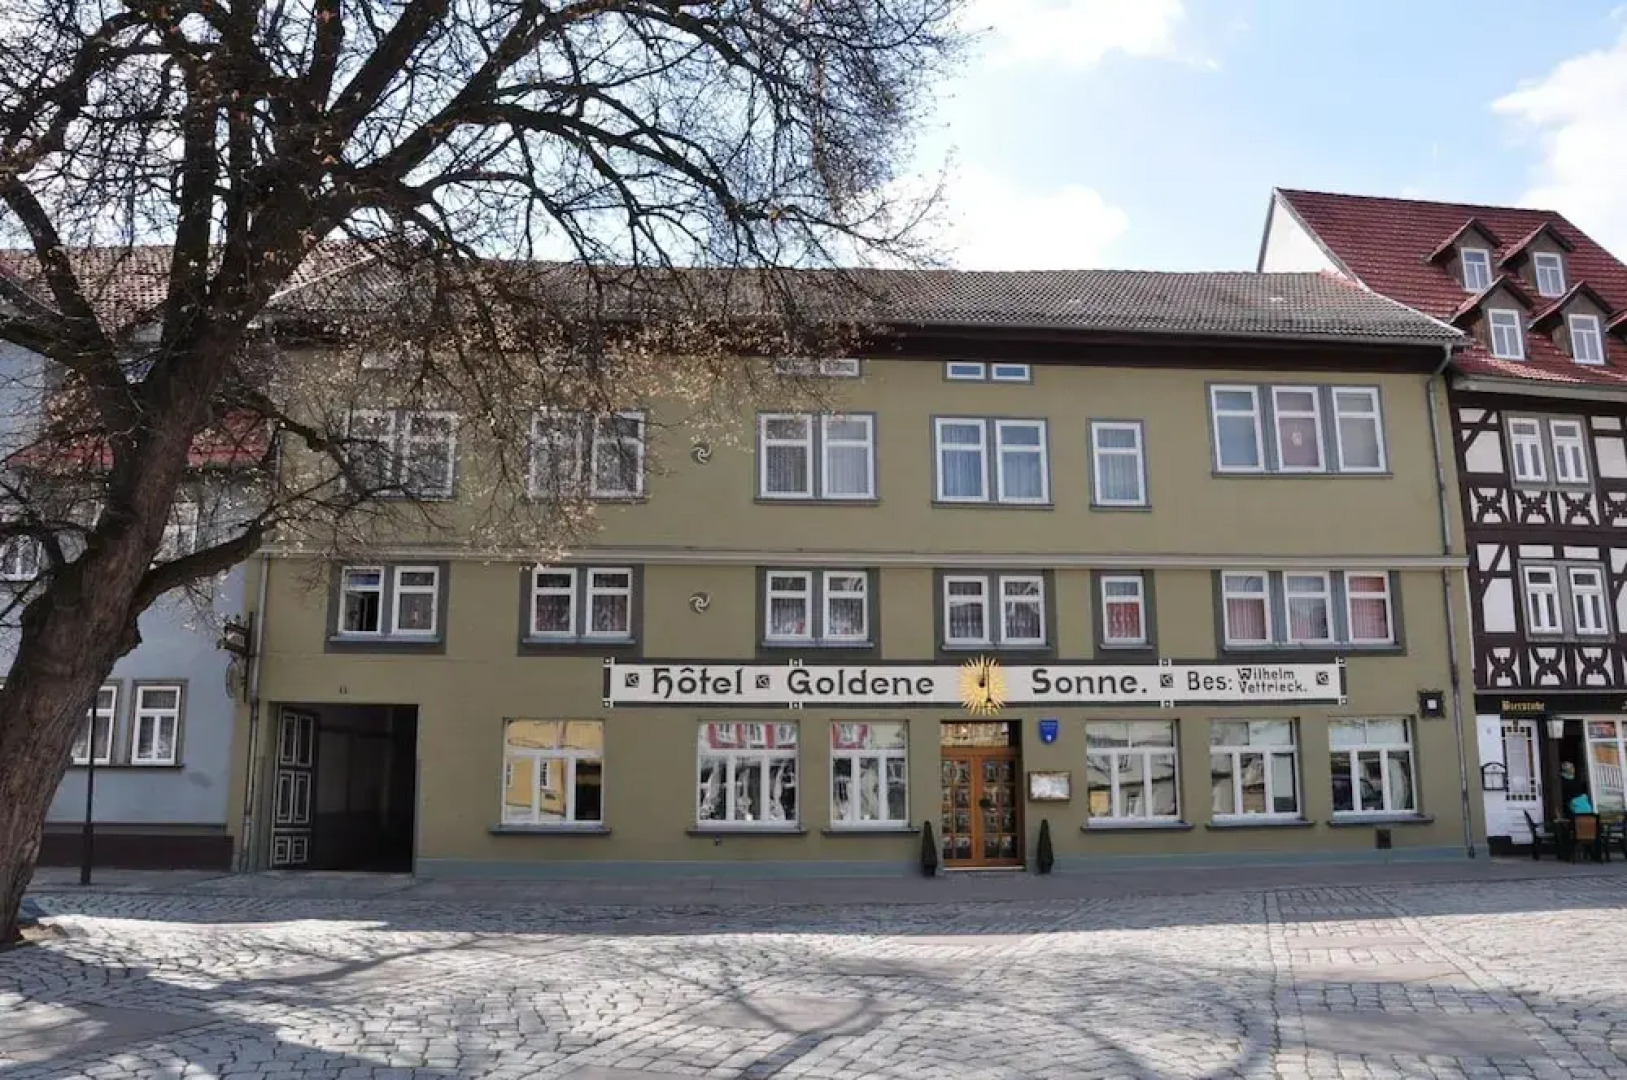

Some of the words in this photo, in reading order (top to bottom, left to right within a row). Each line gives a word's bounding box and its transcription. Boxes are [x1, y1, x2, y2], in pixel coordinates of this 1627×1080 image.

[652, 666, 743, 699] Hôtel
[787, 668, 935, 695] Goldene
[1031, 668, 1148, 694] Sonne.
[1187, 670, 1233, 691] Bes:
[1237, 667, 1295, 681] Wilhelm
